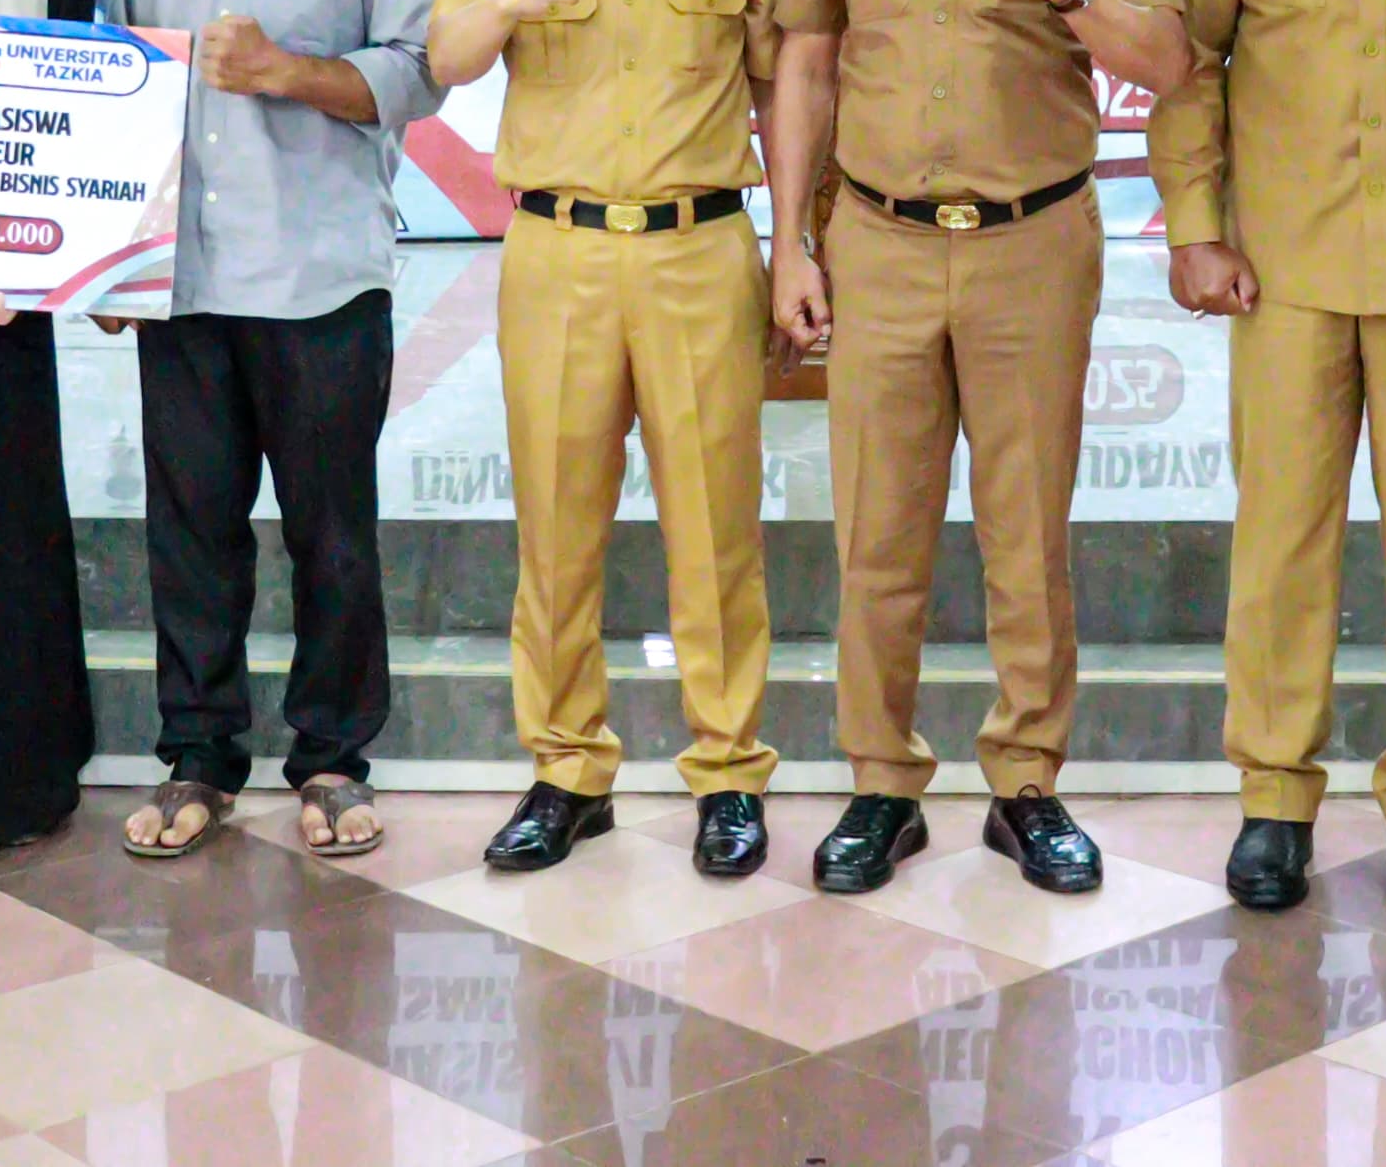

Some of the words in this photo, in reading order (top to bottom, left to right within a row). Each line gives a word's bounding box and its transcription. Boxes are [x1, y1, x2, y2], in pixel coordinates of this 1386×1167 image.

[7, 44, 133, 68] UNIVERSITAS
[34, 64, 103, 83] TAZKIA
[0, 174, 59, 196] BISNIS
[66, 178, 145, 202] SYARIAH
